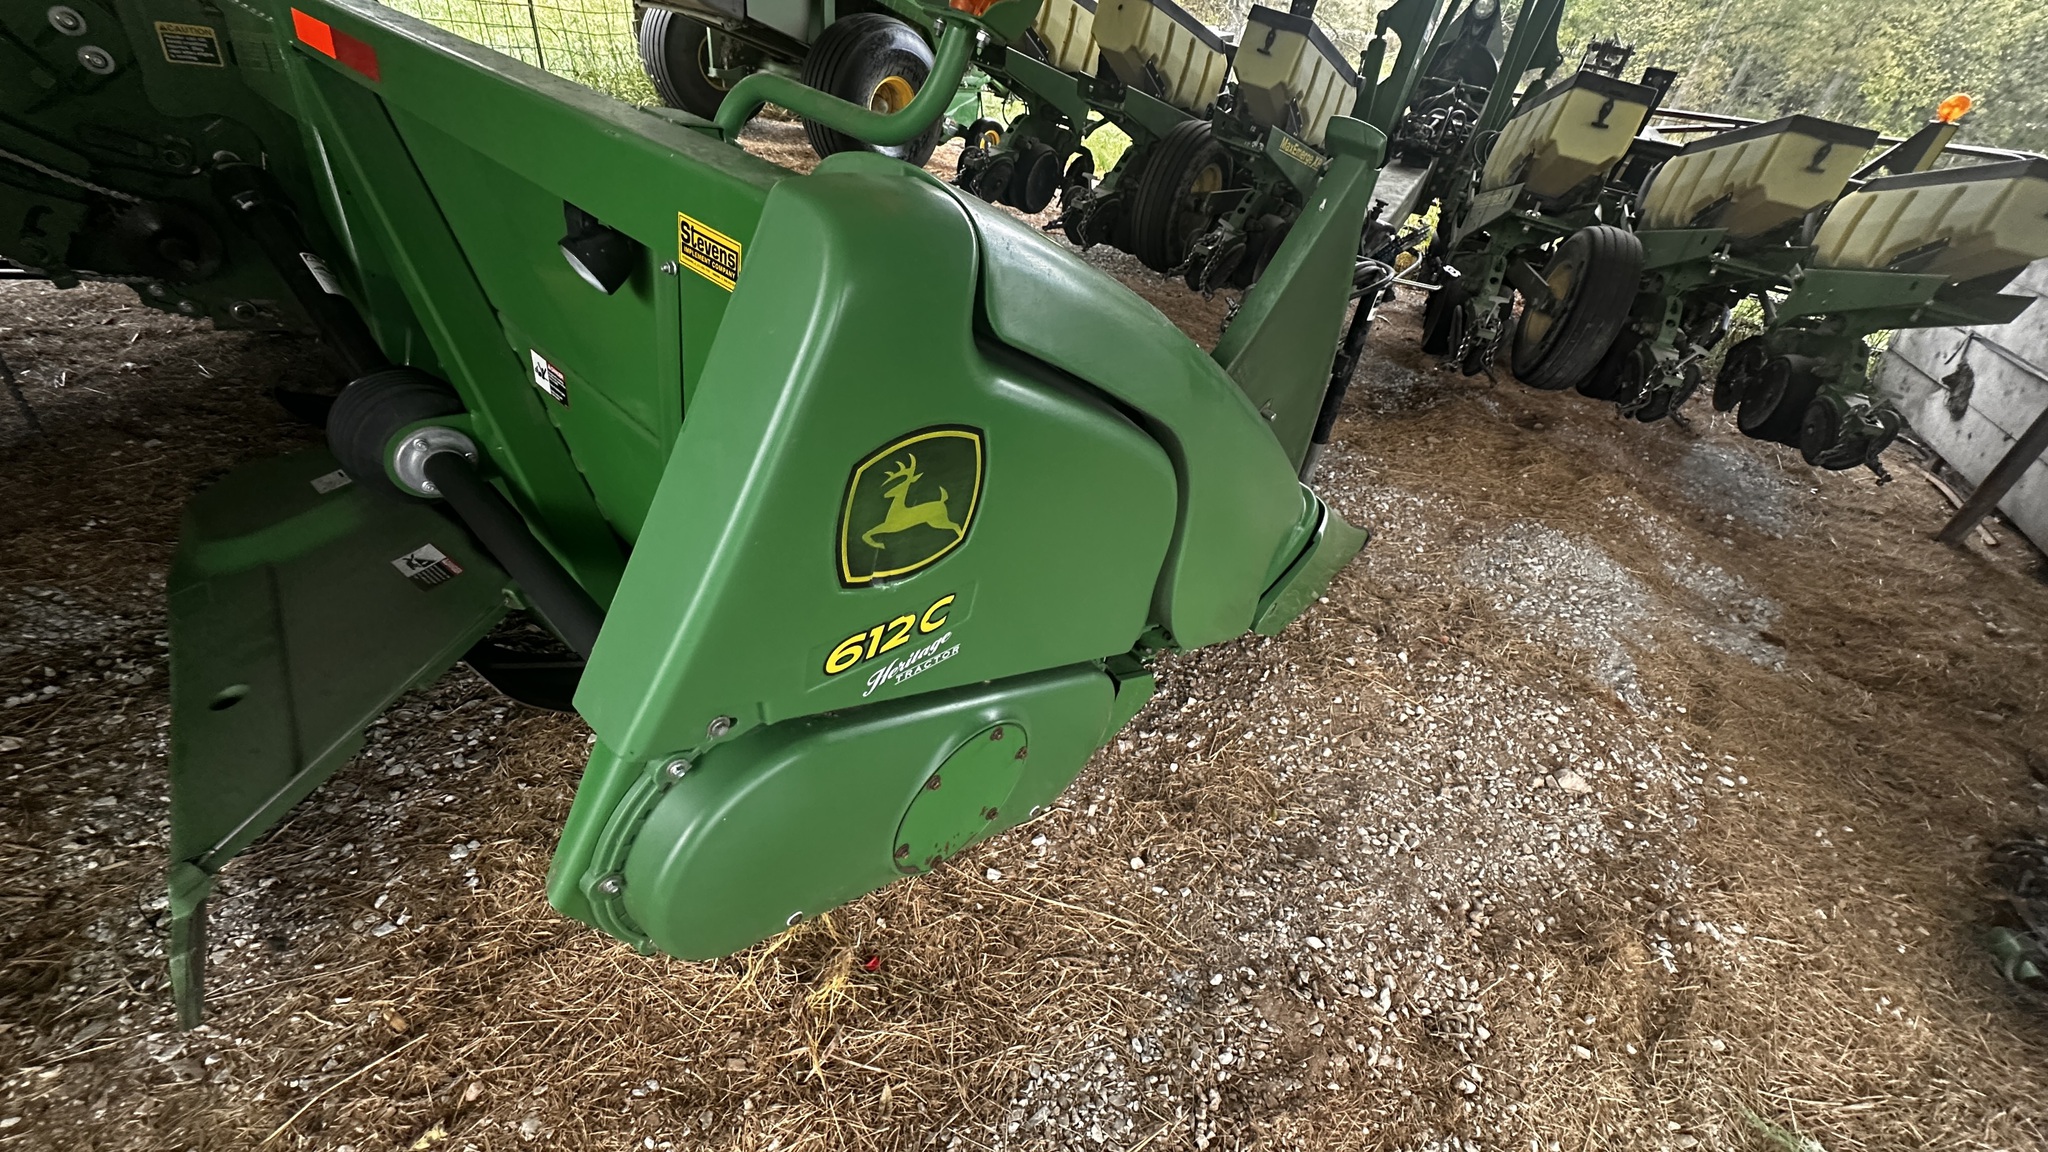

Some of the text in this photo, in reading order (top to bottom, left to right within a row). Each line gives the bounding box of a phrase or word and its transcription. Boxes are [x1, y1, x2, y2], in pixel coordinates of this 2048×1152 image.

[166, 24, 213, 36] CAUTION
[1280, 136, 1314, 165] MaxEmerge
[681, 220, 736, 269] Stevens
[683, 245, 711, 265] IMPLEMENT
[711, 260, 736, 279] COMPANY
[862, 631, 952, 697] Heritage
[896, 645, 960, 684] TRACTOR
